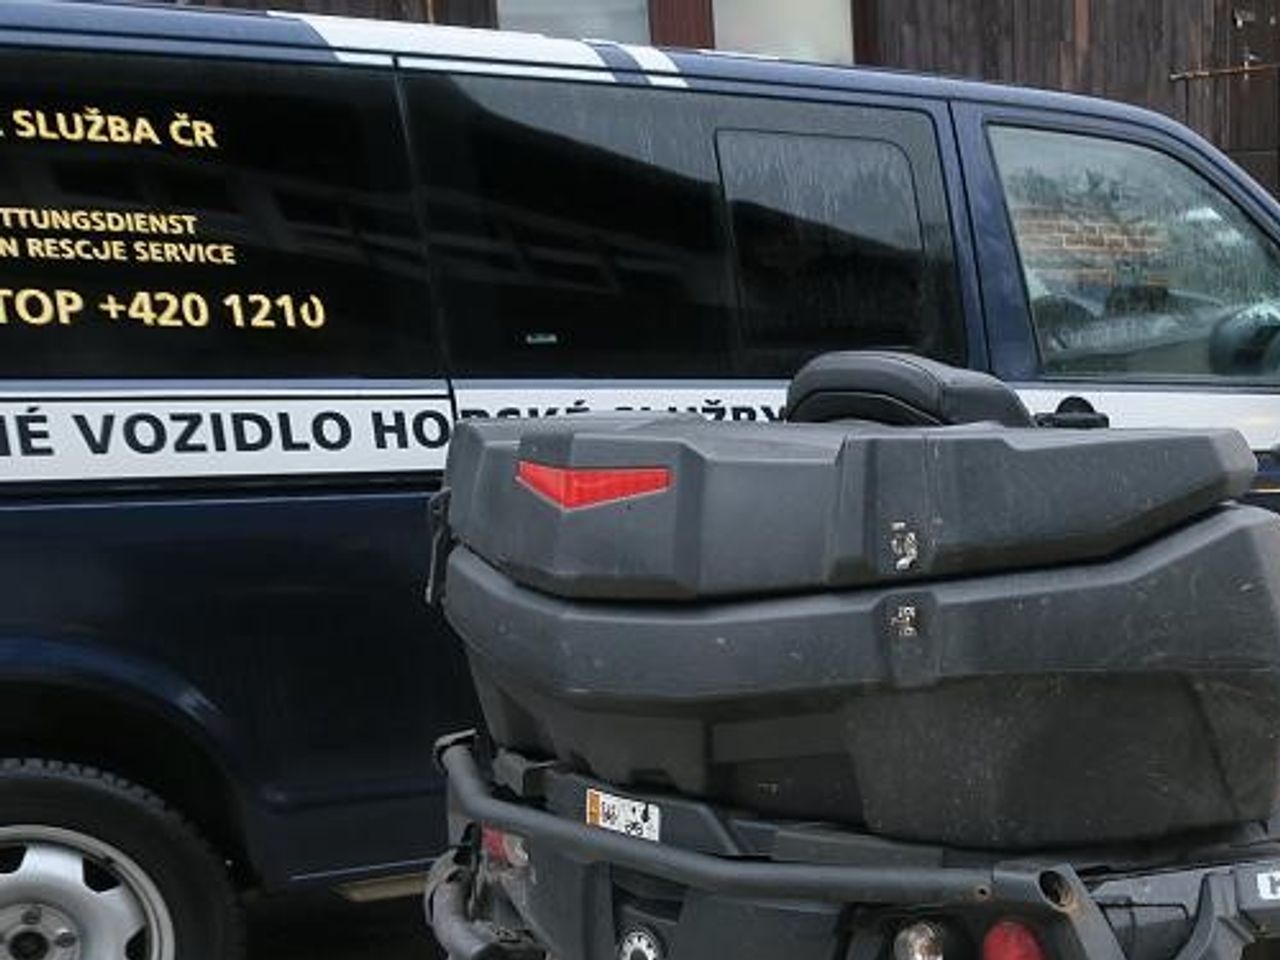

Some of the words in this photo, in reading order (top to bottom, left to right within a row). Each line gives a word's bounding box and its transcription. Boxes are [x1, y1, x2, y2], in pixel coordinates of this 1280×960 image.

[12, 106, 161, 145] SLUŽBA
[168, 112, 218, 147] ČR
[133, 241, 237, 264] SERVICE
[99, 291, 209, 327] +420
[223, 294, 325, 328] 1210
[72, 411, 352, 455] VOZIDLO
